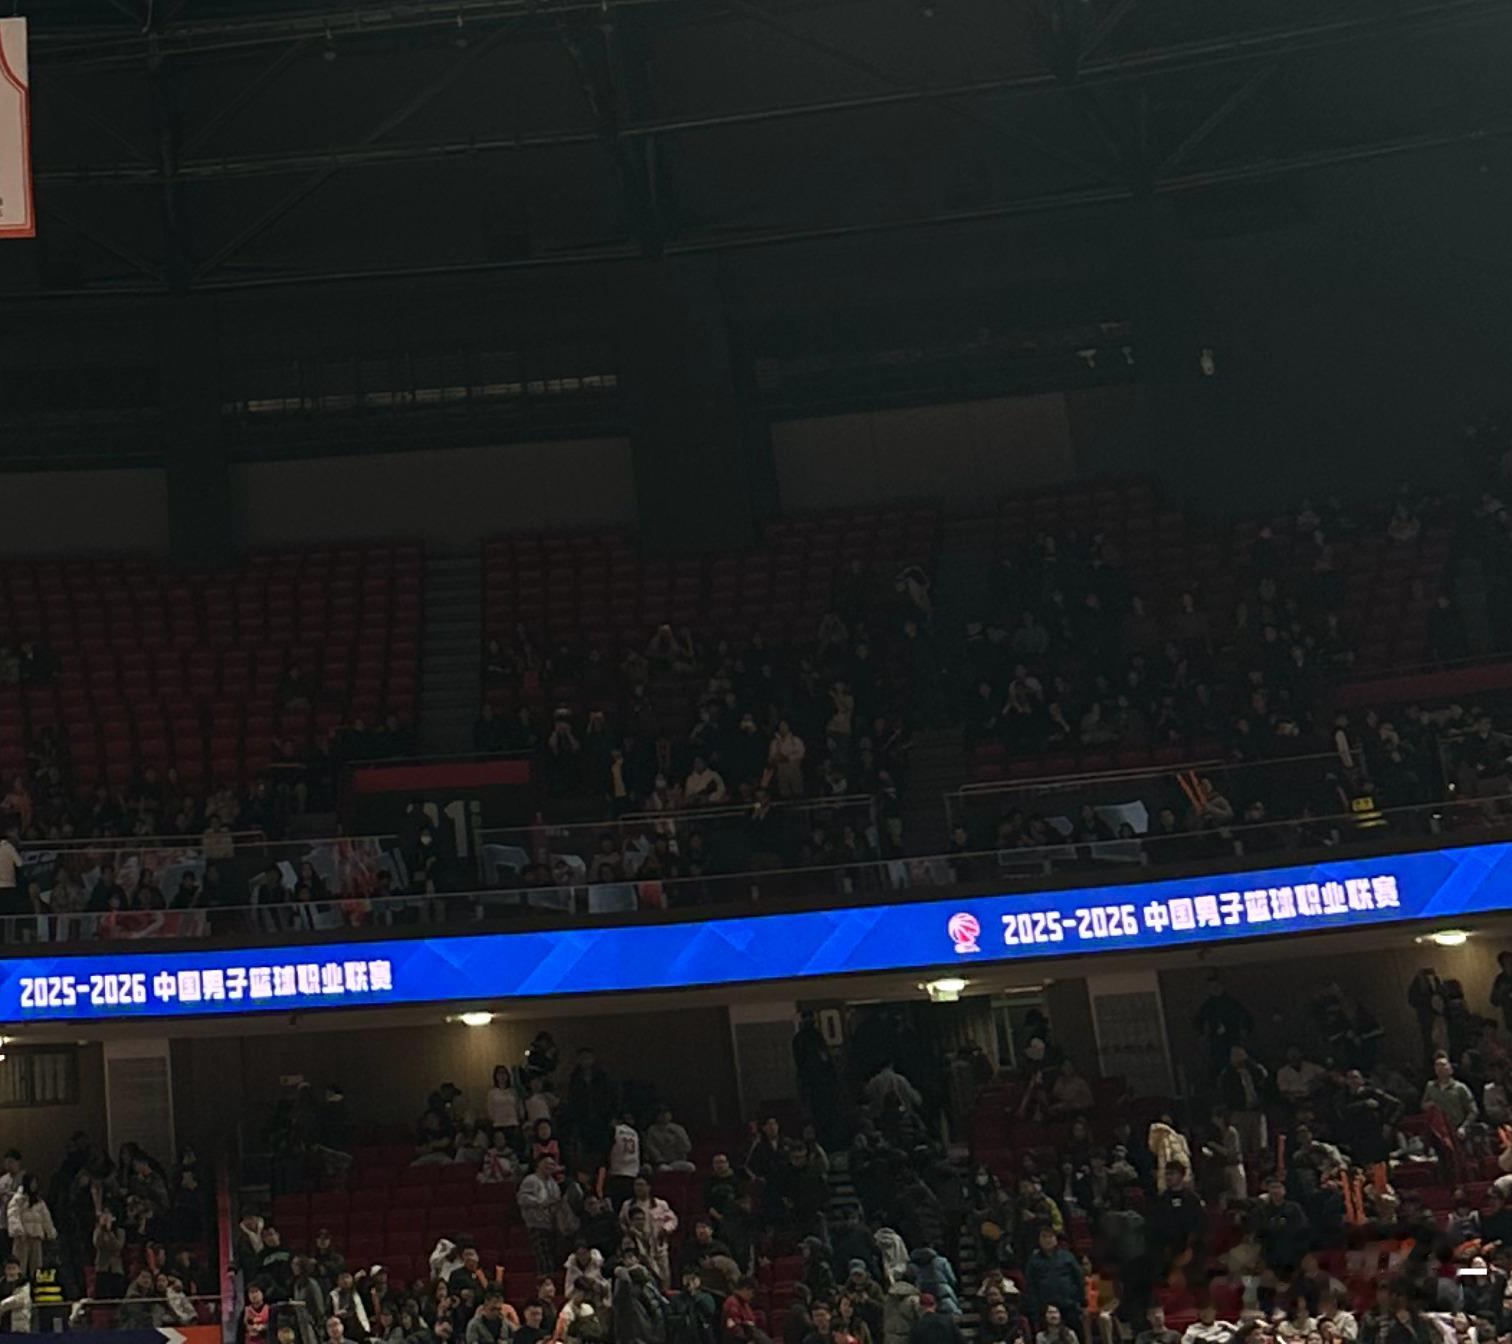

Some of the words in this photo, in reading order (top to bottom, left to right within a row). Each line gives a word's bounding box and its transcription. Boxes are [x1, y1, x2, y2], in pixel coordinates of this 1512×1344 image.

[1001, 903, 1138, 945] 2025-2026
[1144, 875, 1400, 933] 中国男子篮球职业联赛
[20, 974, 146, 1007] 2025-2026
[154, 960, 392, 1003] 中国男子篮球职业联赛
